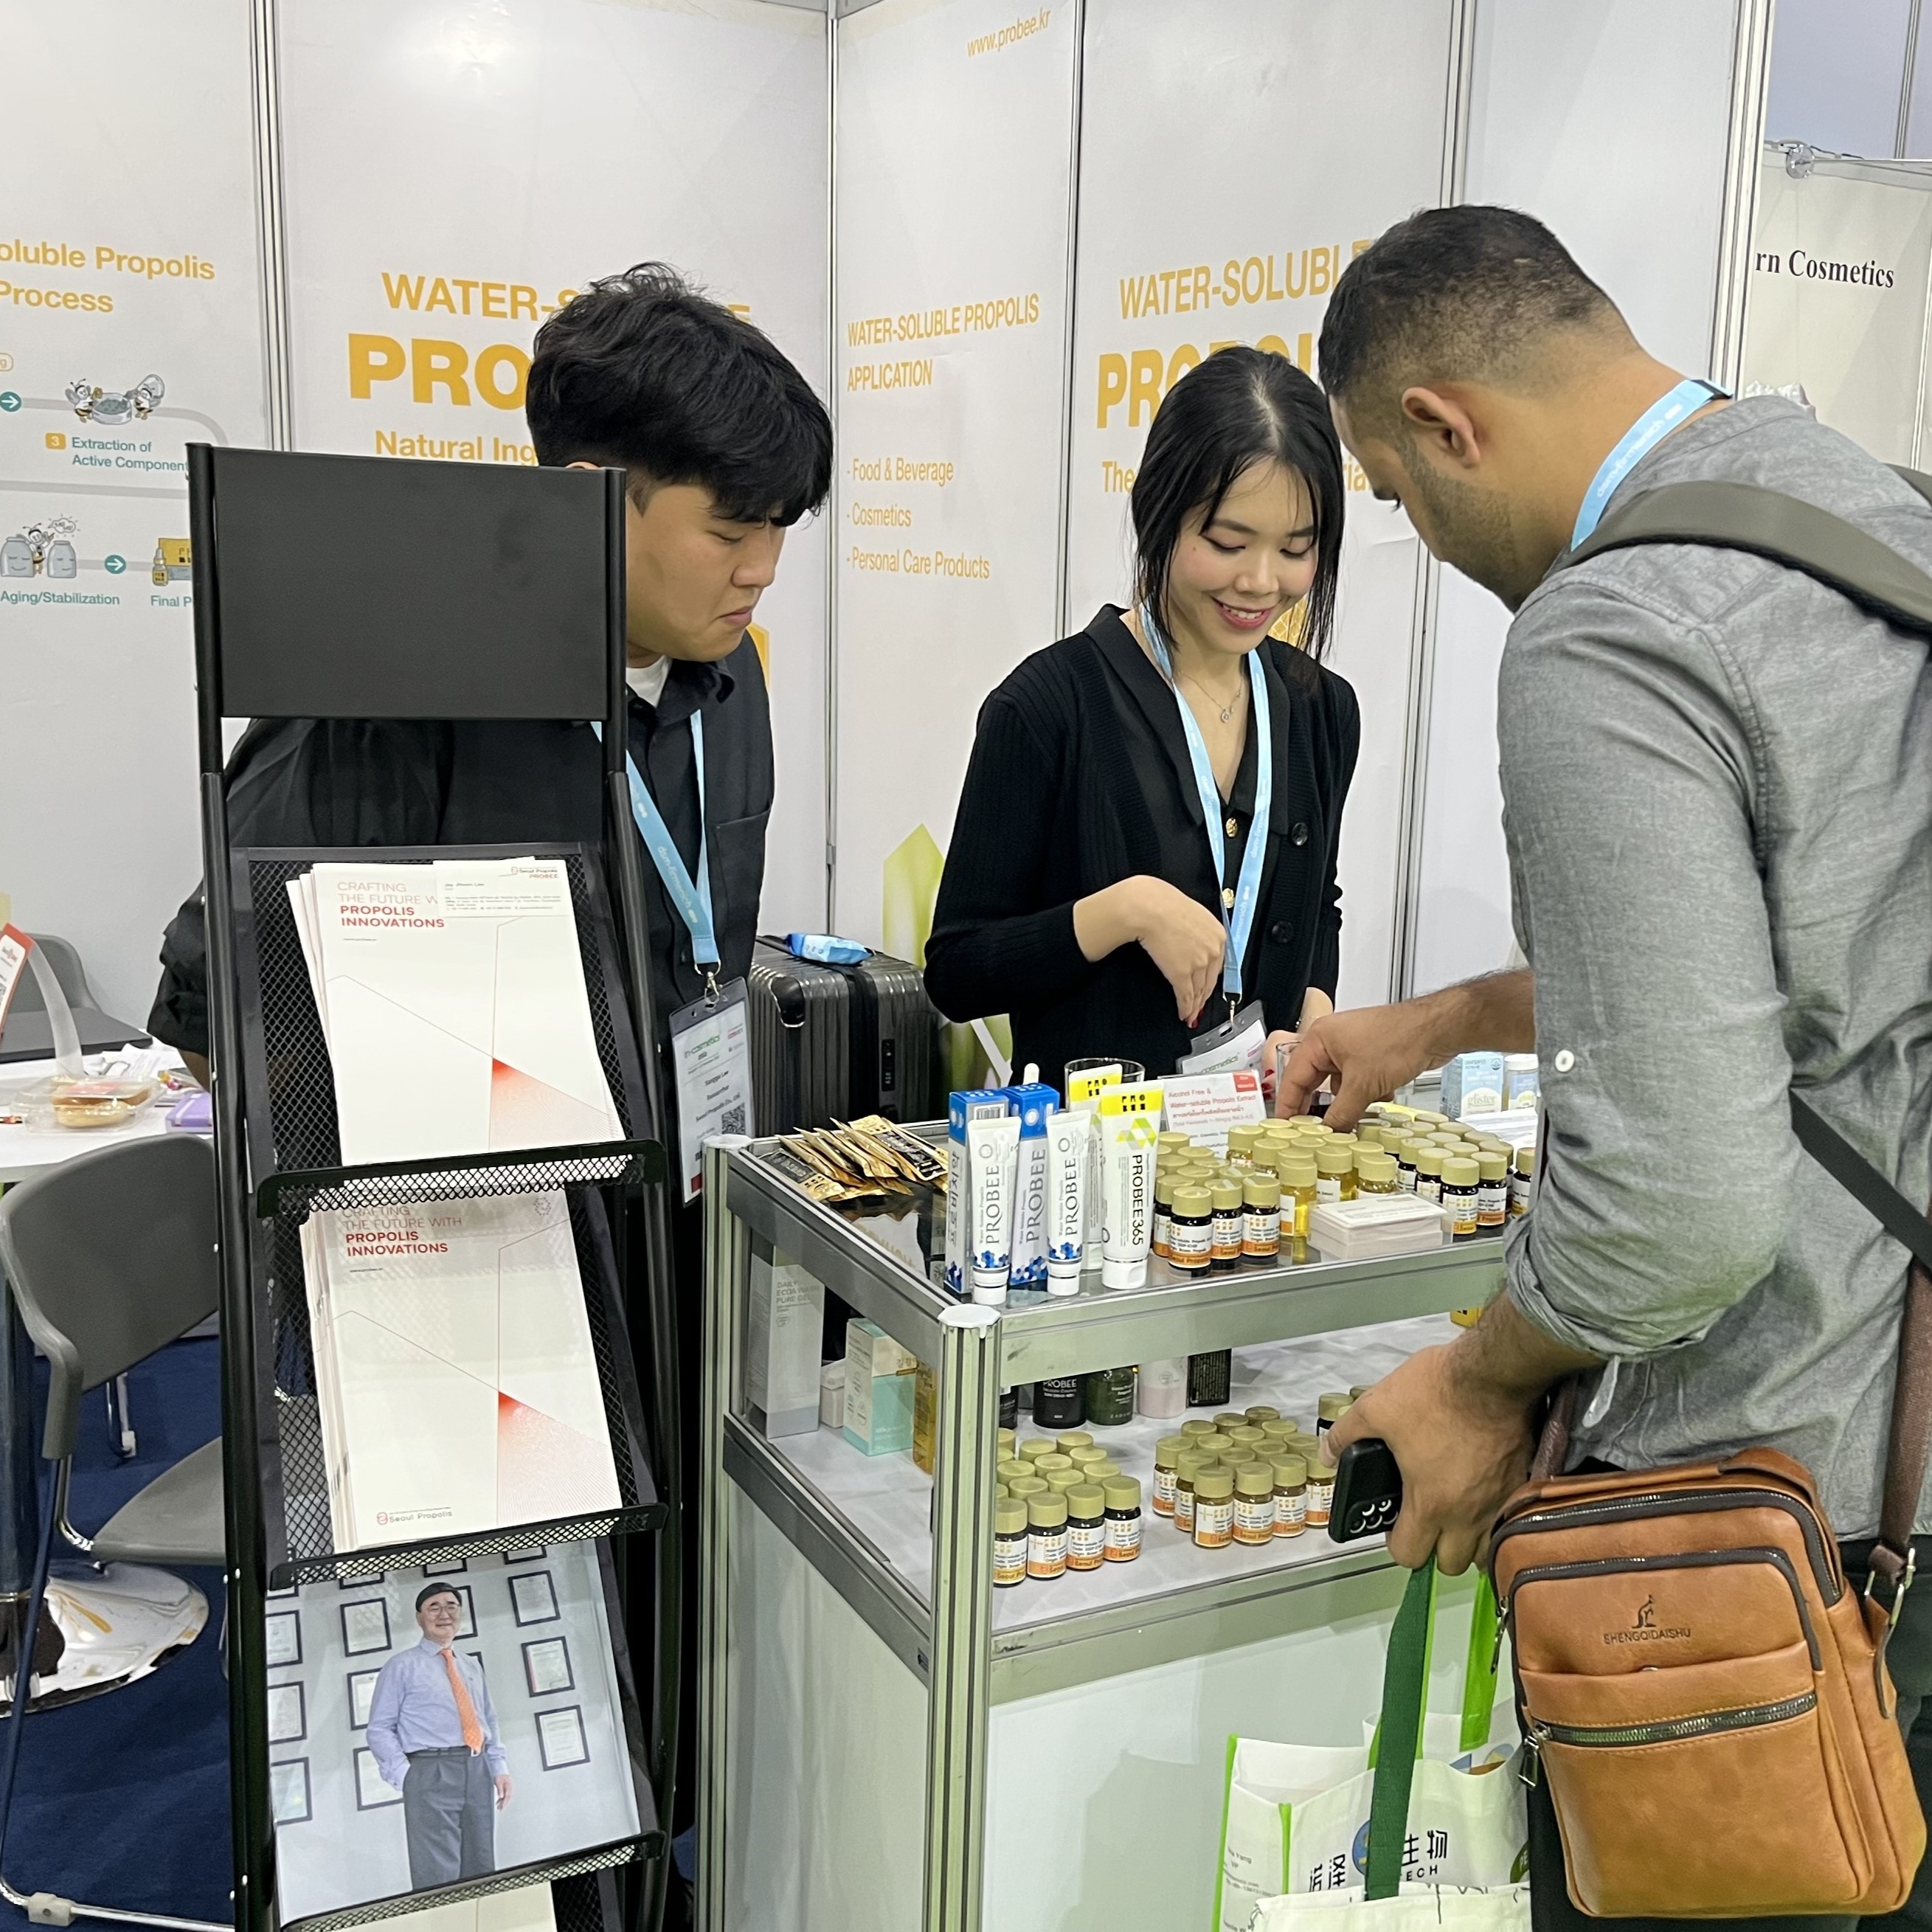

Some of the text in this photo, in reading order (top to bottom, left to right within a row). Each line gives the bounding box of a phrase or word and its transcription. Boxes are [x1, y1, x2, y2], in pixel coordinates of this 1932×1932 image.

[967, 7, 1051, 58] www.probee.kr
[0, 239, 215, 280] oluble Propolis
[1755, 249, 1894, 288] rn Cosmetics
[848, 293, 1039, 347] WATER-SOLUBLE PROPOLIS
[347, 333, 533, 411] PRO
[848, 359, 932, 392] APPLICATION
[72, 437, 152, 452] Extraction of
[375, 430, 482, 463] Natural
[72, 454, 189, 471] Active Component
[853, 457, 954, 488] Food & Beverage
[852, 502, 912, 527] Cosmetics
[852, 546, 990, 579] Personal Care Products
[0, 590, 120, 606] Aging/Stabilization
[151, 595, 193, 607] Final P
[337, 882, 407, 893] CRAFTING
[338, 893, 366, 904] THE
[370, 894, 421, 904] FUTURE
[425, 895, 438, 904] W
[340, 905, 415, 916] PROPOLIS
[341, 917, 446, 928] INNOVATIONS
[986, 1166, 1003, 1244] PROBEE
[1026, 1149, 1046, 1243] PROBEE
[1064, 1157, 1081, 1236] PROBEE
[1132, 1154, 1144, 1247] PROBEE365
[344, 1216, 463, 1232] THE FUTURE WITH
[345, 1230, 419, 1244] PROPOLIS
[347, 1242, 449, 1257] INNOVATIONS
[1603, 1627, 1691, 1645] SHENGQIDAISHU
[1405, 1864, 1438, 1882] ECH
